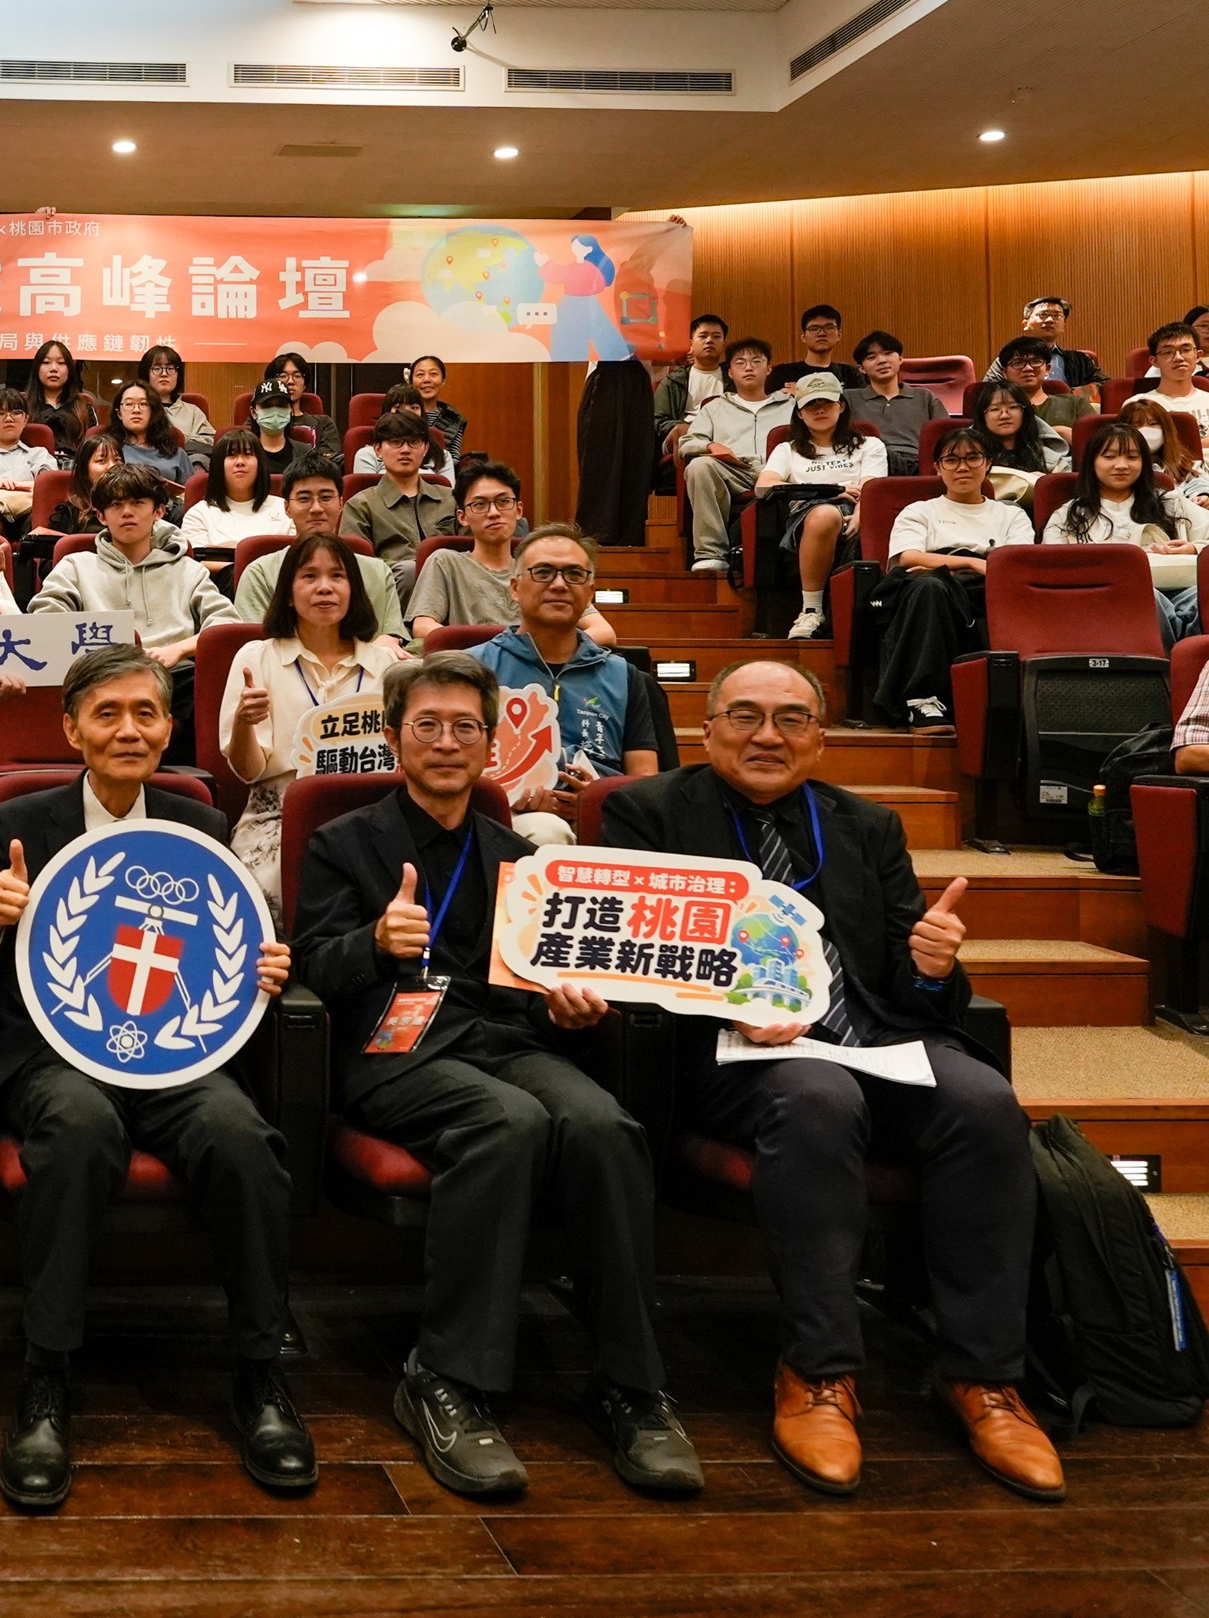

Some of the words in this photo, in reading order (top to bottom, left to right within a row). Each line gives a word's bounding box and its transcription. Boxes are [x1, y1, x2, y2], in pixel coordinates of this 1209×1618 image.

[320, 709, 385, 739] 立足桃
[315, 743, 395, 775] 驅動台灣
[542, 891, 733, 946] 打造桃園
[530, 932, 739, 987] 產業新戰略
